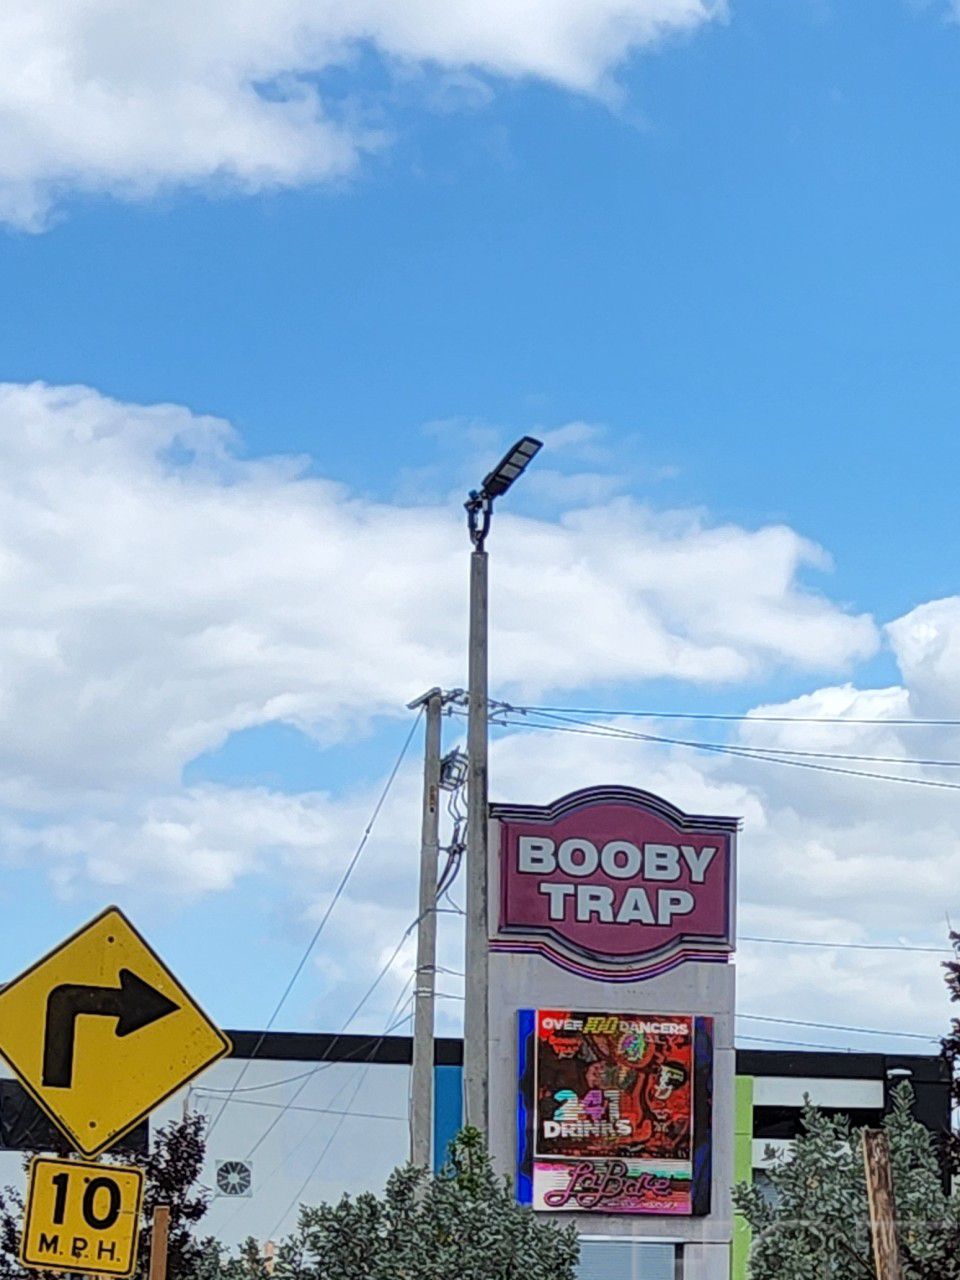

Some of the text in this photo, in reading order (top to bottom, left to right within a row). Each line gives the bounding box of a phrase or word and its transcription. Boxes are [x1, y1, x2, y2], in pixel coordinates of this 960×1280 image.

[518, 836, 718, 883] BOOBY
[538, 882, 695, 926] TRAP
[542, 1017, 583, 1031] OVER
[619, 1020, 689, 1035] DANCERS
[543, 1119, 633, 1139] DRINKS
[52, 1172, 122, 1230] 10
